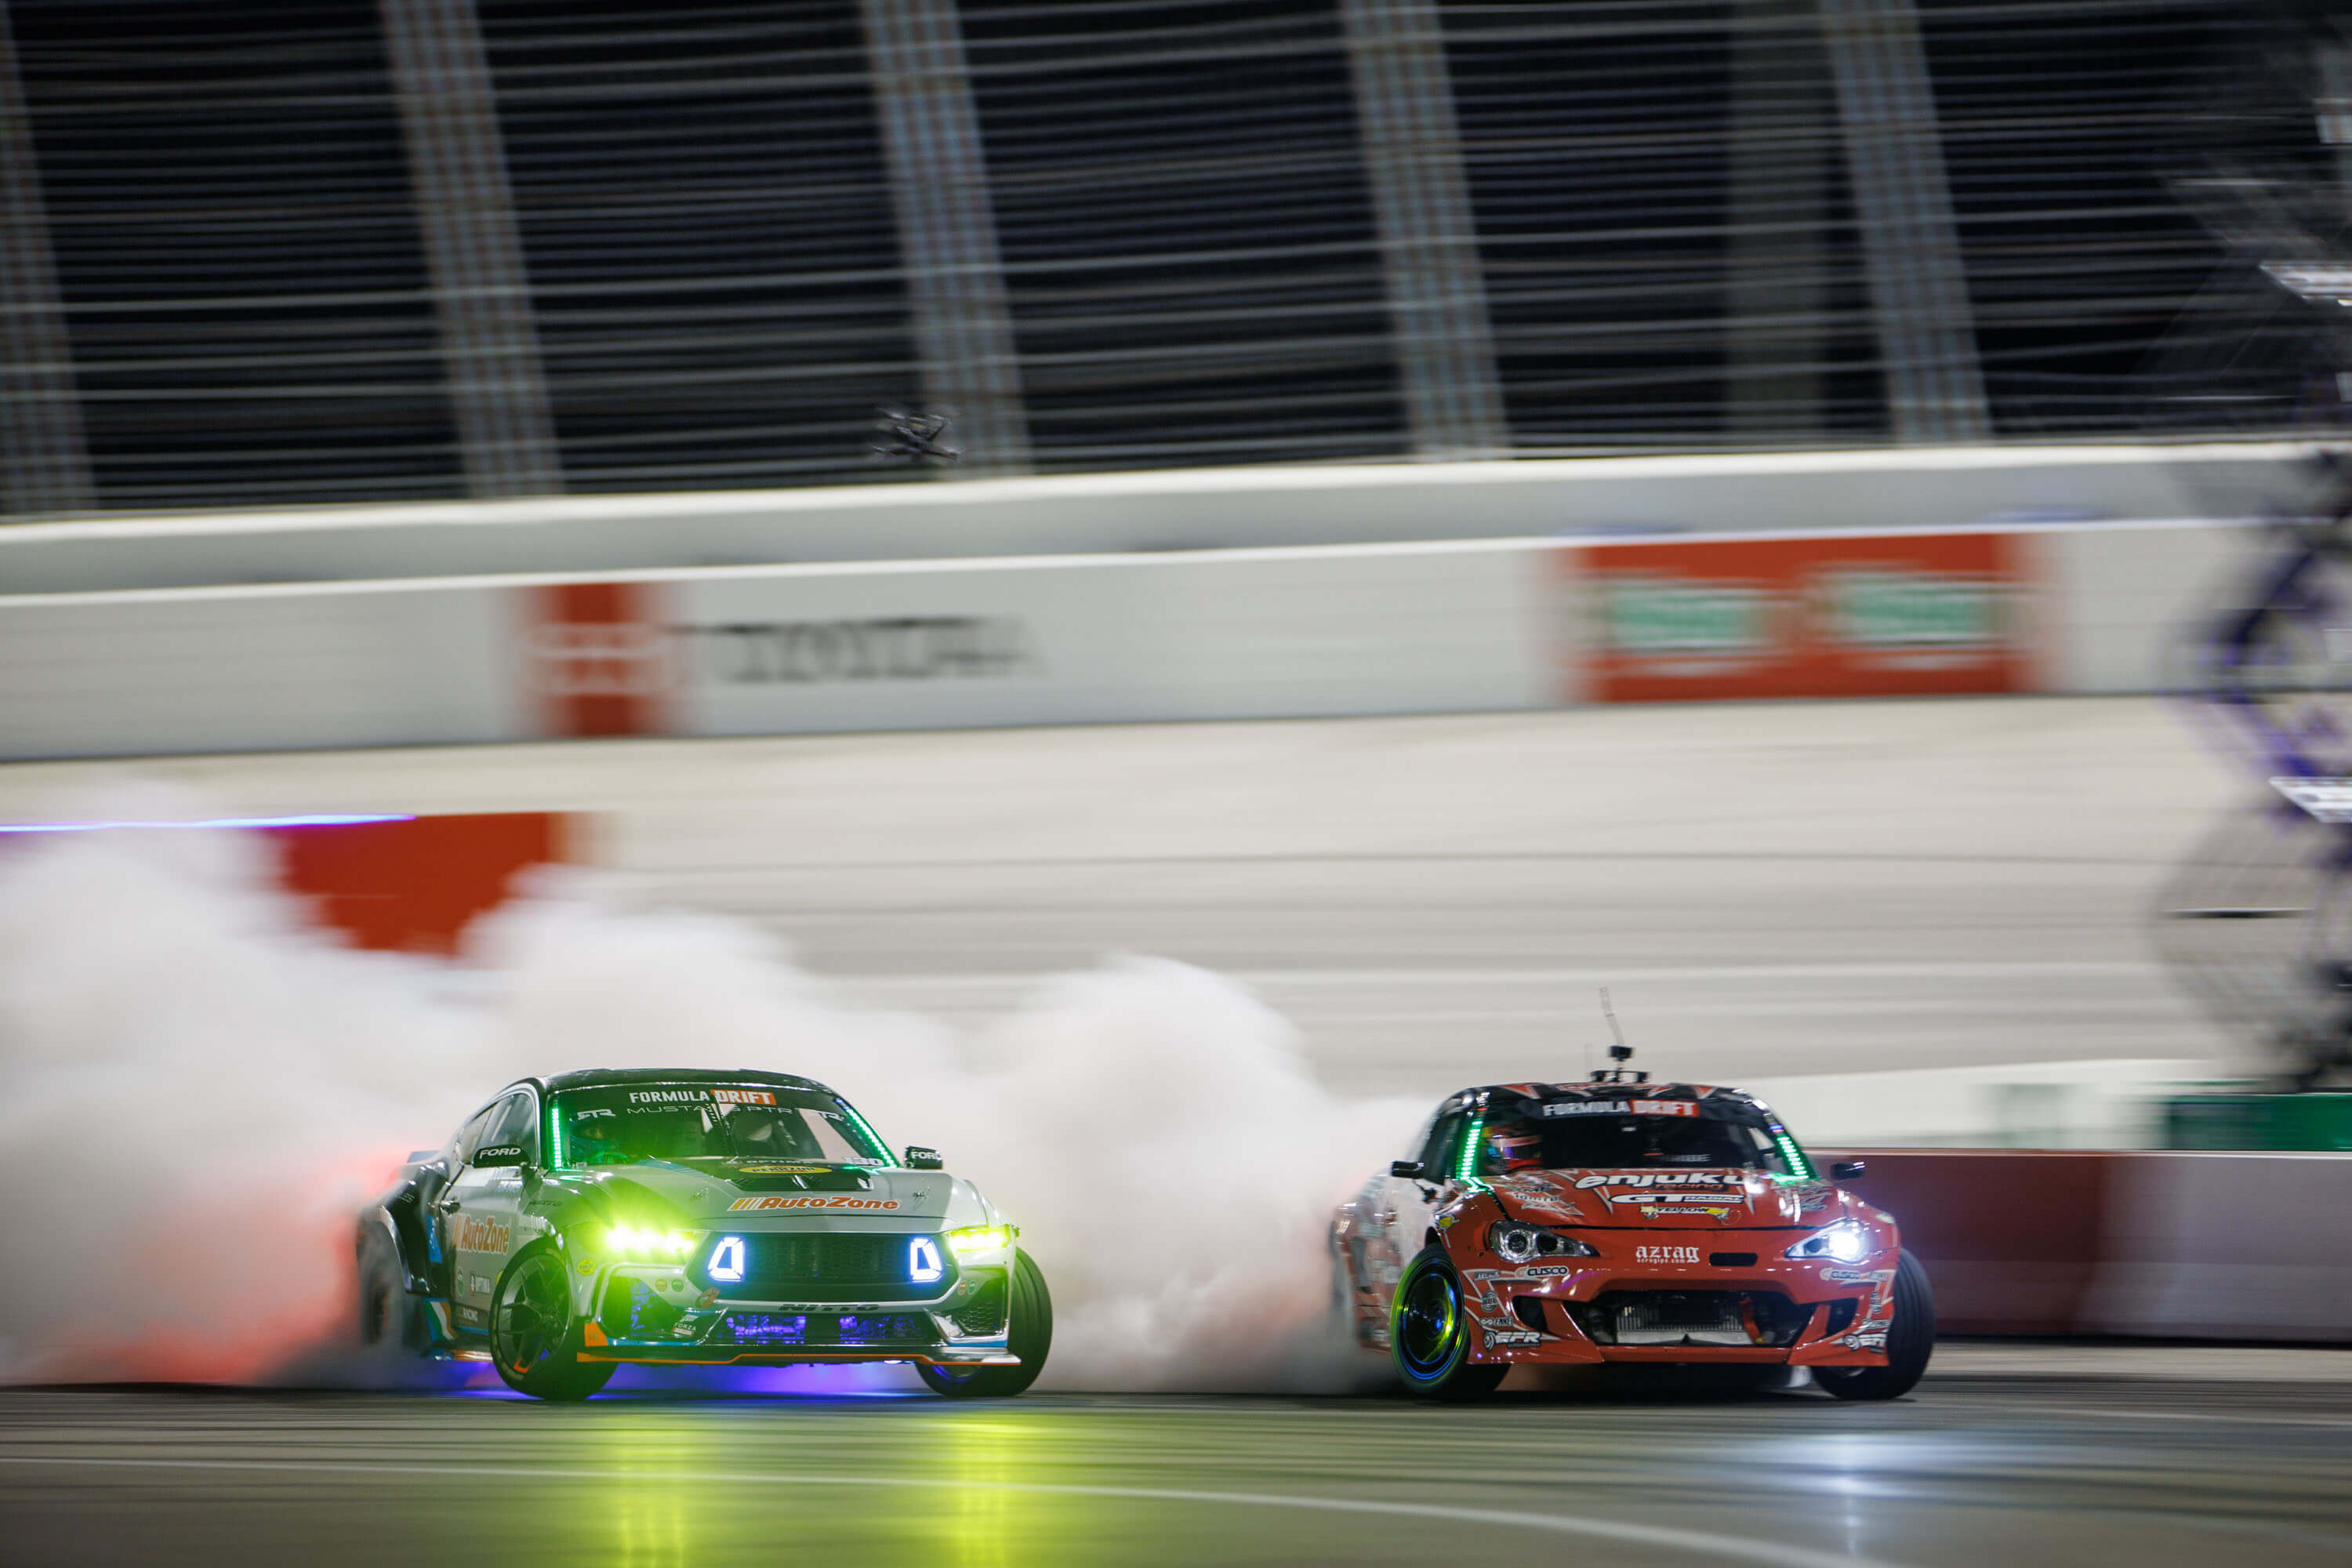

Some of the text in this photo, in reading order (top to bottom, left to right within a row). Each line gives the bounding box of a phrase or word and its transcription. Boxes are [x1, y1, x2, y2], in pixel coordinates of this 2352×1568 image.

[629, 1090, 771, 1105] FORMULA DRIFT
[626, 1105, 741, 1114] MUSTAG
[479, 1147, 521, 1160] FORD
[757, 1196, 899, 1210] AutoZone
[1610, 1193, 1685, 1203] GT
[461, 1215, 510, 1254] AutoZone
[1635, 1246, 1700, 1264] azrag
[1526, 1266, 1568, 1276] CUSCO
